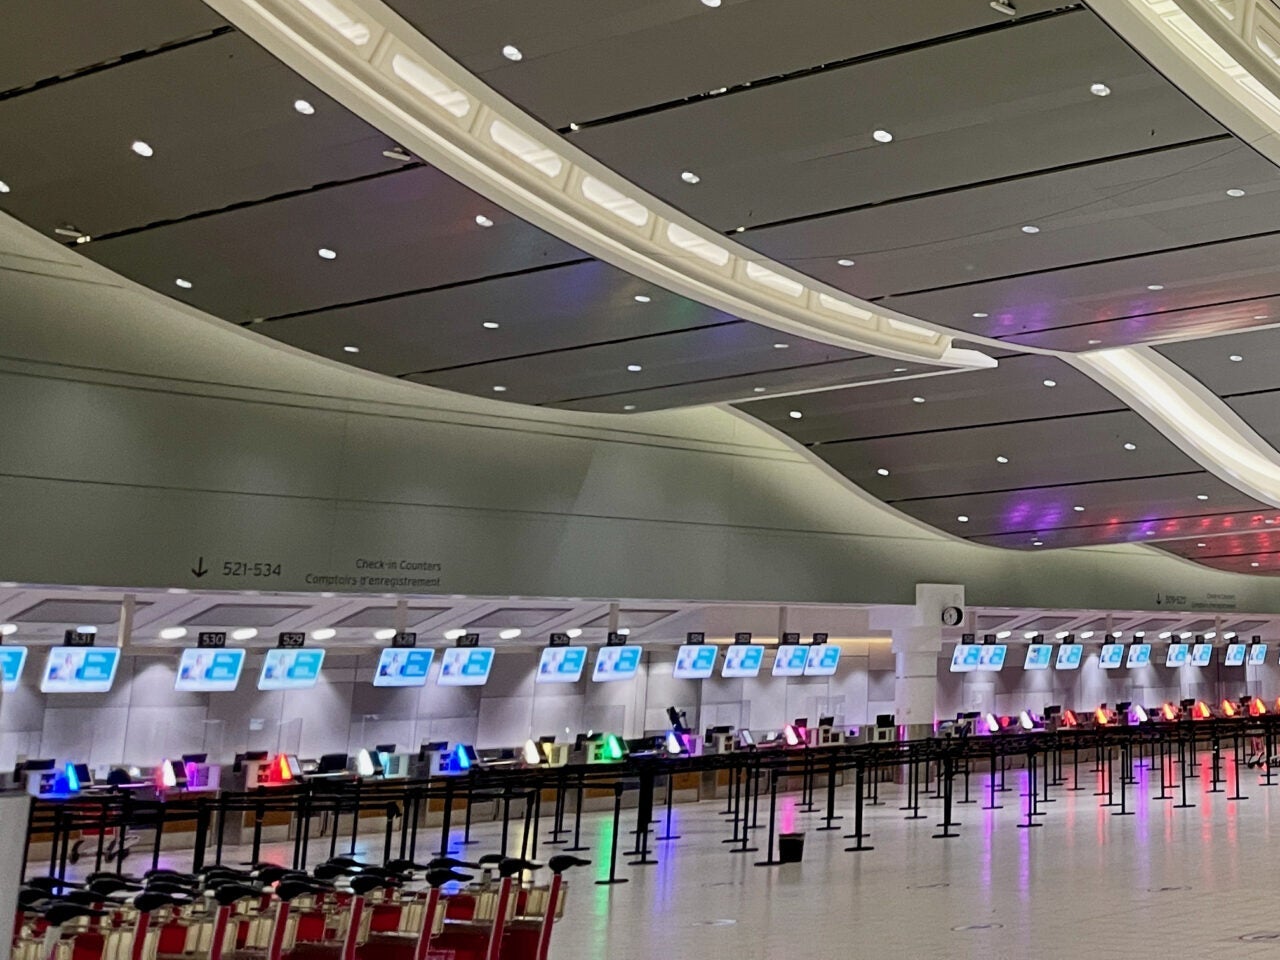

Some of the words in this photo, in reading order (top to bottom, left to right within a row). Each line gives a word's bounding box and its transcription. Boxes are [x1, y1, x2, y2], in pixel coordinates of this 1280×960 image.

[222, 560, 282, 578] 521-534
[355, 558, 398, 571] Check-in
[399, 558, 442, 572] Counters
[305, 572, 358, 587] Comptoirs
[202, 634, 224, 645] 530
[283, 634, 304, 645] 529
